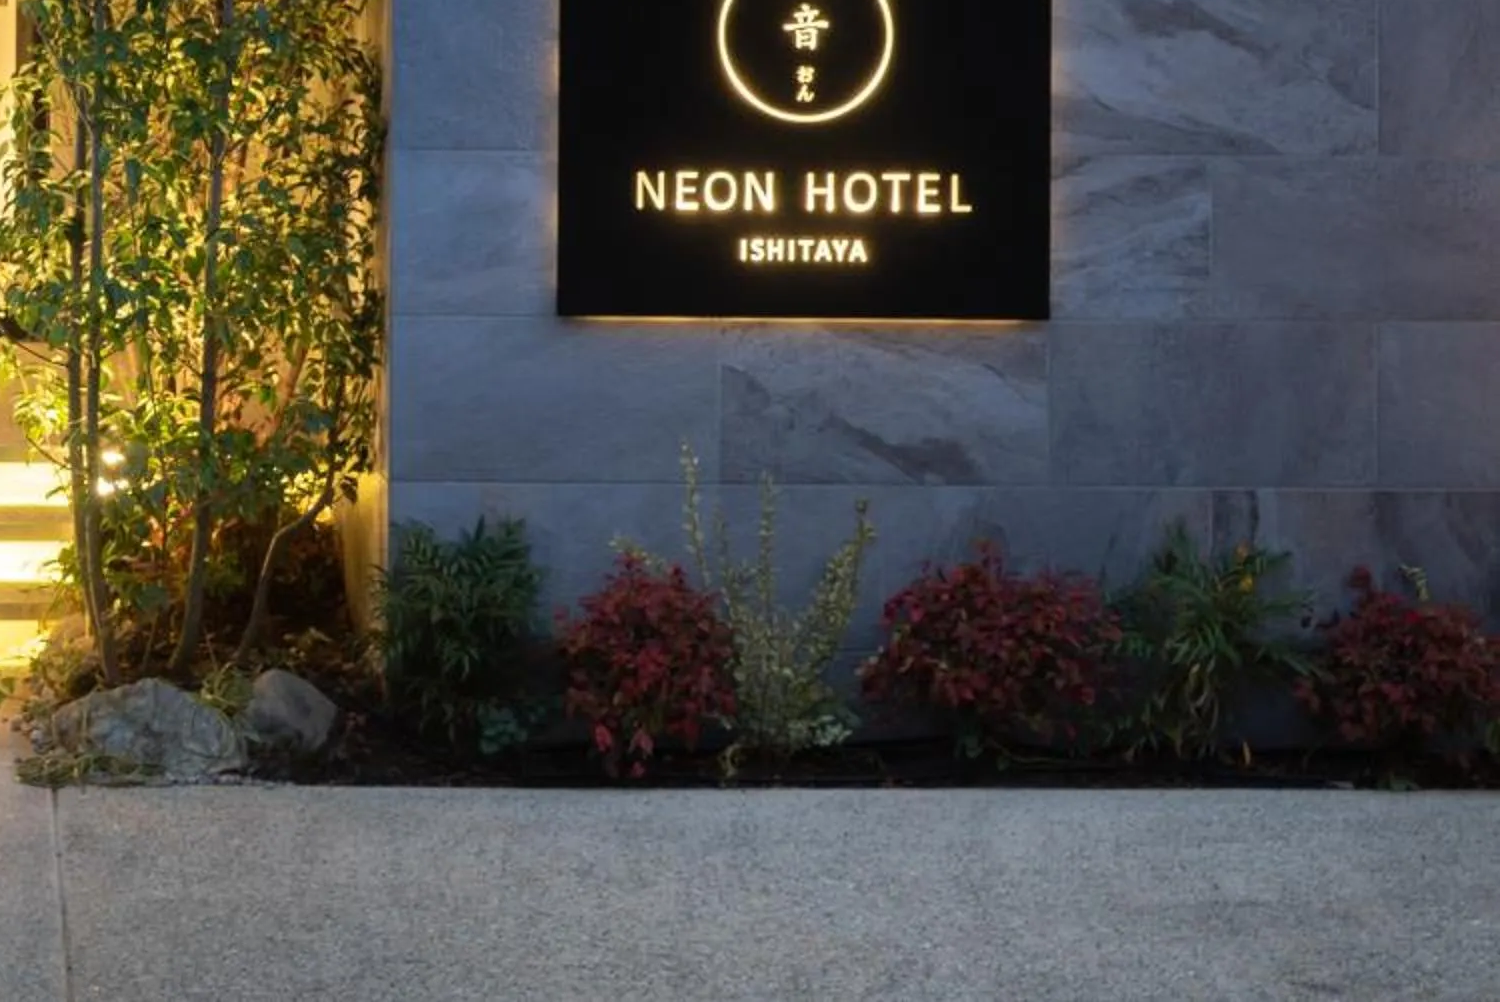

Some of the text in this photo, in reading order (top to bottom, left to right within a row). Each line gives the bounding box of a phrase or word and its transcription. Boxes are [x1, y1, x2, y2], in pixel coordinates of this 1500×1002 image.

[635, 170, 973, 214] NEON HOTEL
[738, 238, 868, 263] ISHITAYA
